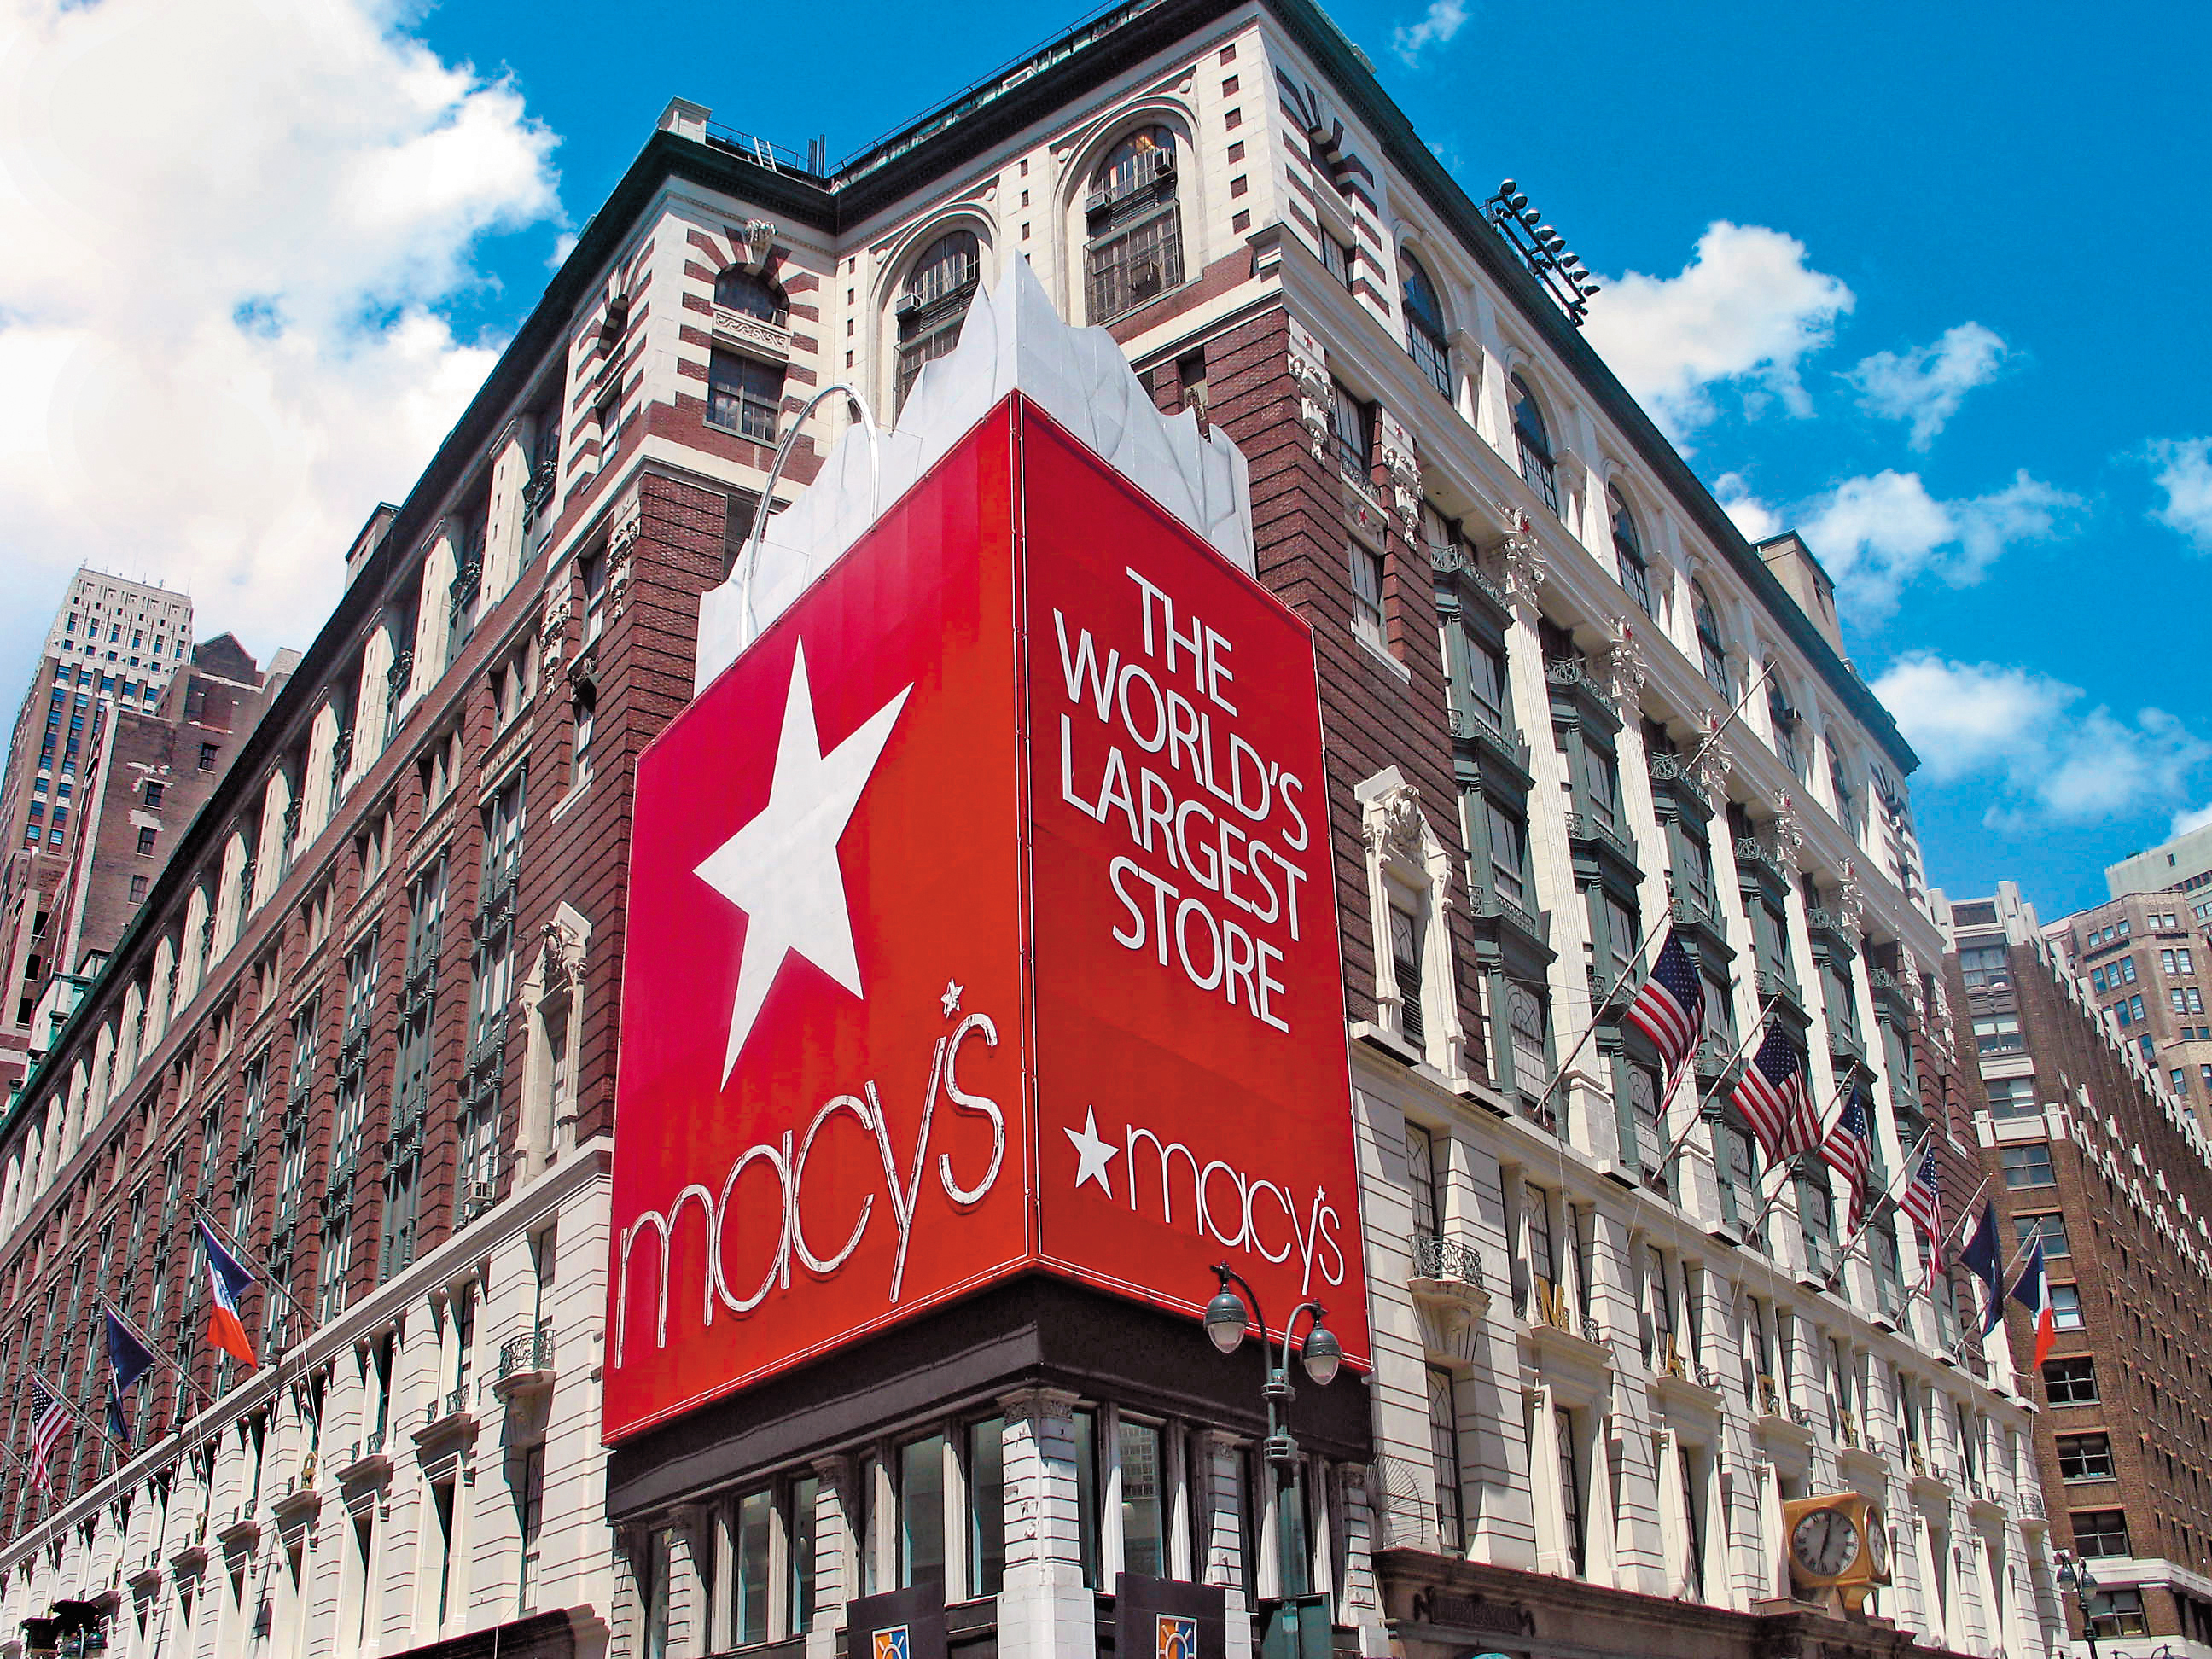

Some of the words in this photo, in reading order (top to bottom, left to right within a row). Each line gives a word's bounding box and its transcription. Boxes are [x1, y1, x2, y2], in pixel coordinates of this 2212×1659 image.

[1053, 608, 1308, 851] WORLD'S
[1126, 566, 1237, 717] THE
[1061, 713, 1307, 942] LARGEST
[1109, 855, 1289, 1033] STORE
